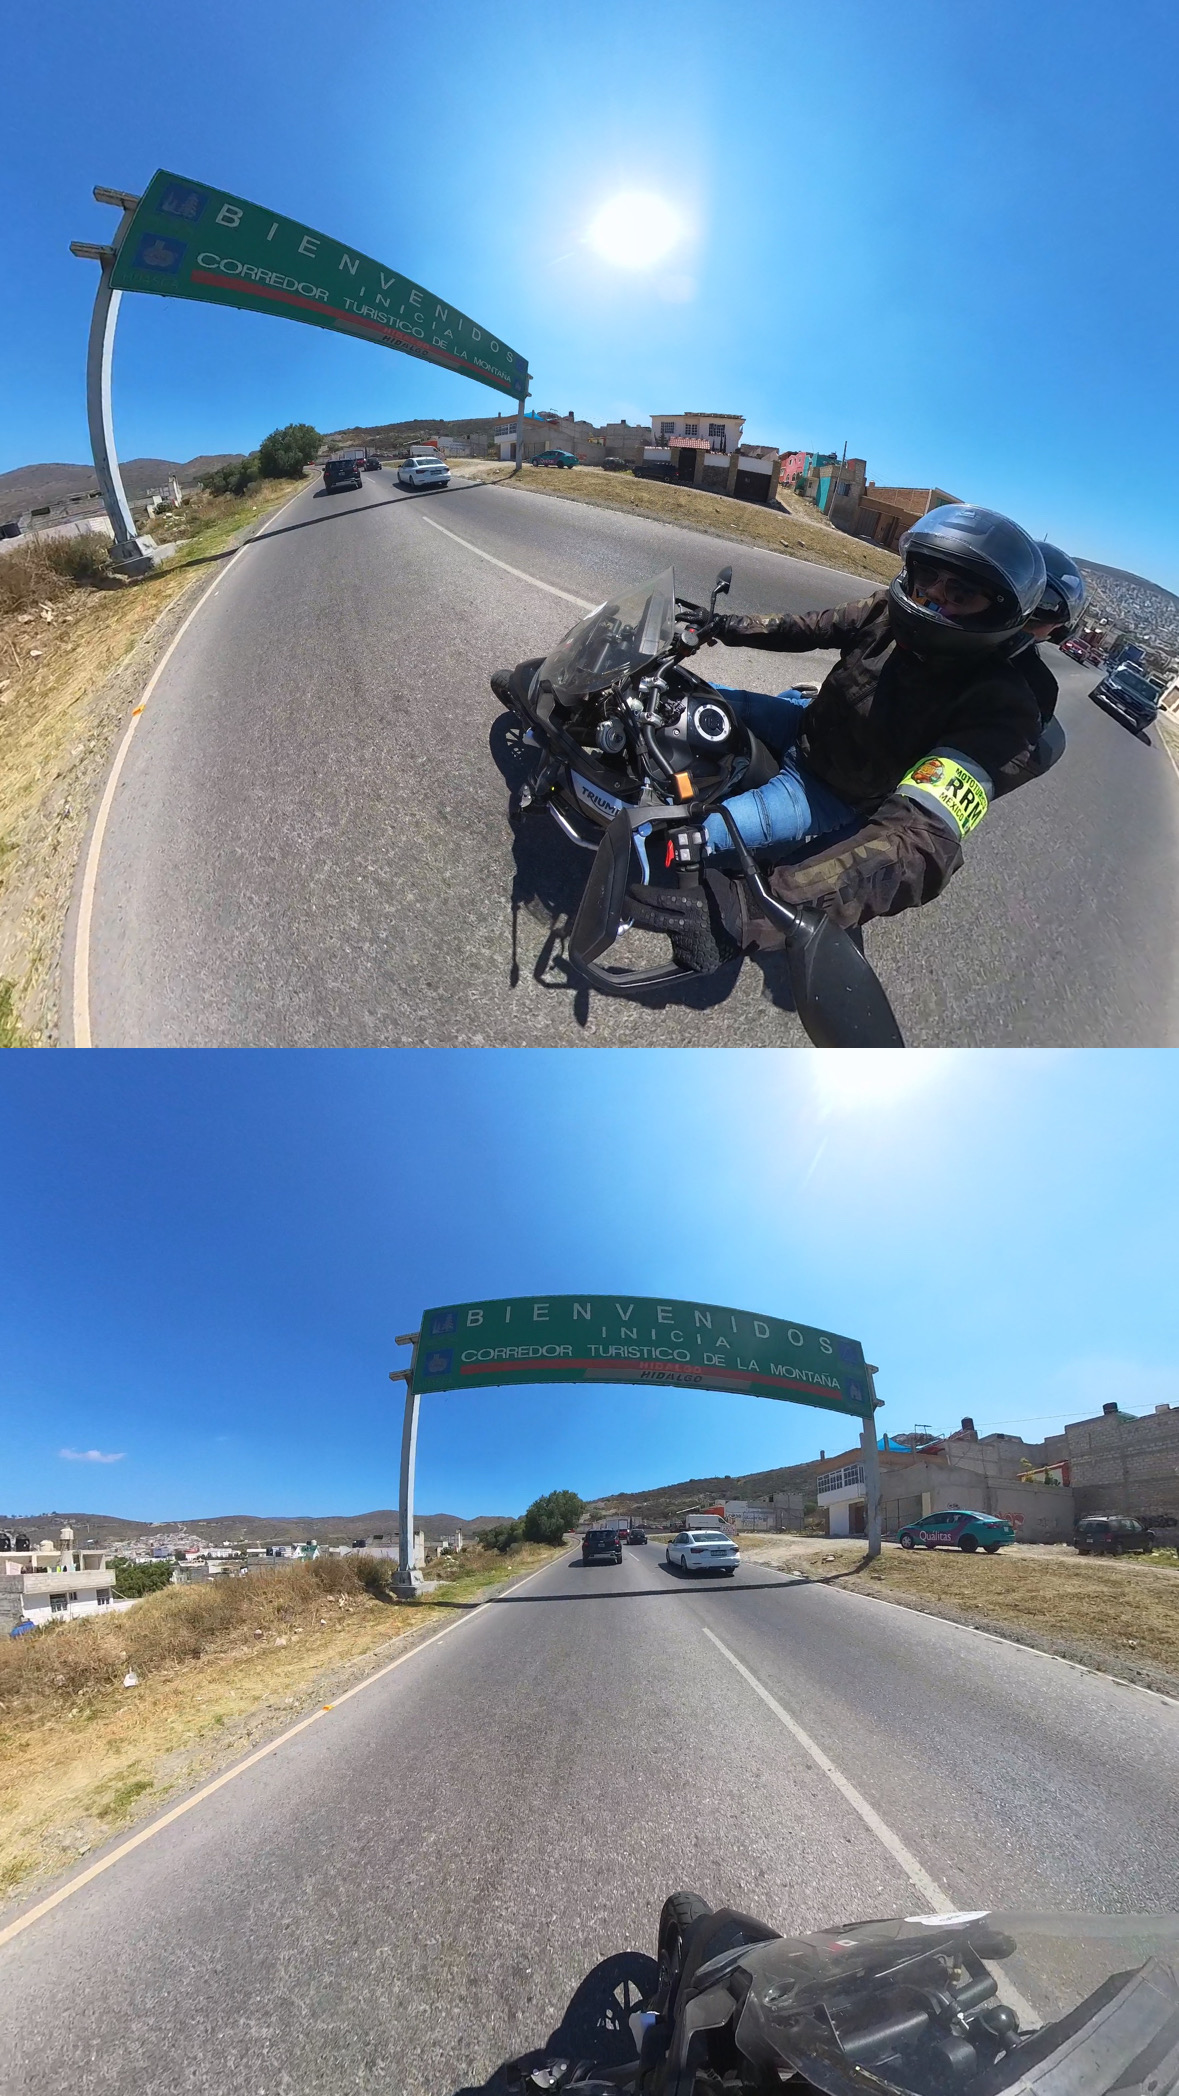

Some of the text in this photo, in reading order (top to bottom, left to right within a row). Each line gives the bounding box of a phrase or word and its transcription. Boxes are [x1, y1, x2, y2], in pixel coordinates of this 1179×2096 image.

[197, 252, 329, 302] CORREDOR
[343, 297, 425, 339] TURISTICO
[432, 336, 448, 350] DE
[454, 346, 468, 360] LA
[215, 203, 515, 363] BIENVENIDOS
[359, 286, 454, 339] INICIA
[382, 335, 429, 356] HIDALGO
[945, 776, 982, 828] RRM
[466, 1303, 833, 1354] BIENVENIDOS
[602, 1327, 731, 1348] INICIA
[461, 1344, 573, 1362] CORREDOR
[587, 1345, 691, 1362] TURISTICO
[703, 1353, 726, 1366] DE
[737, 1357, 759, 1371] LA
[640, 1371, 703, 1383] HIDALGO
